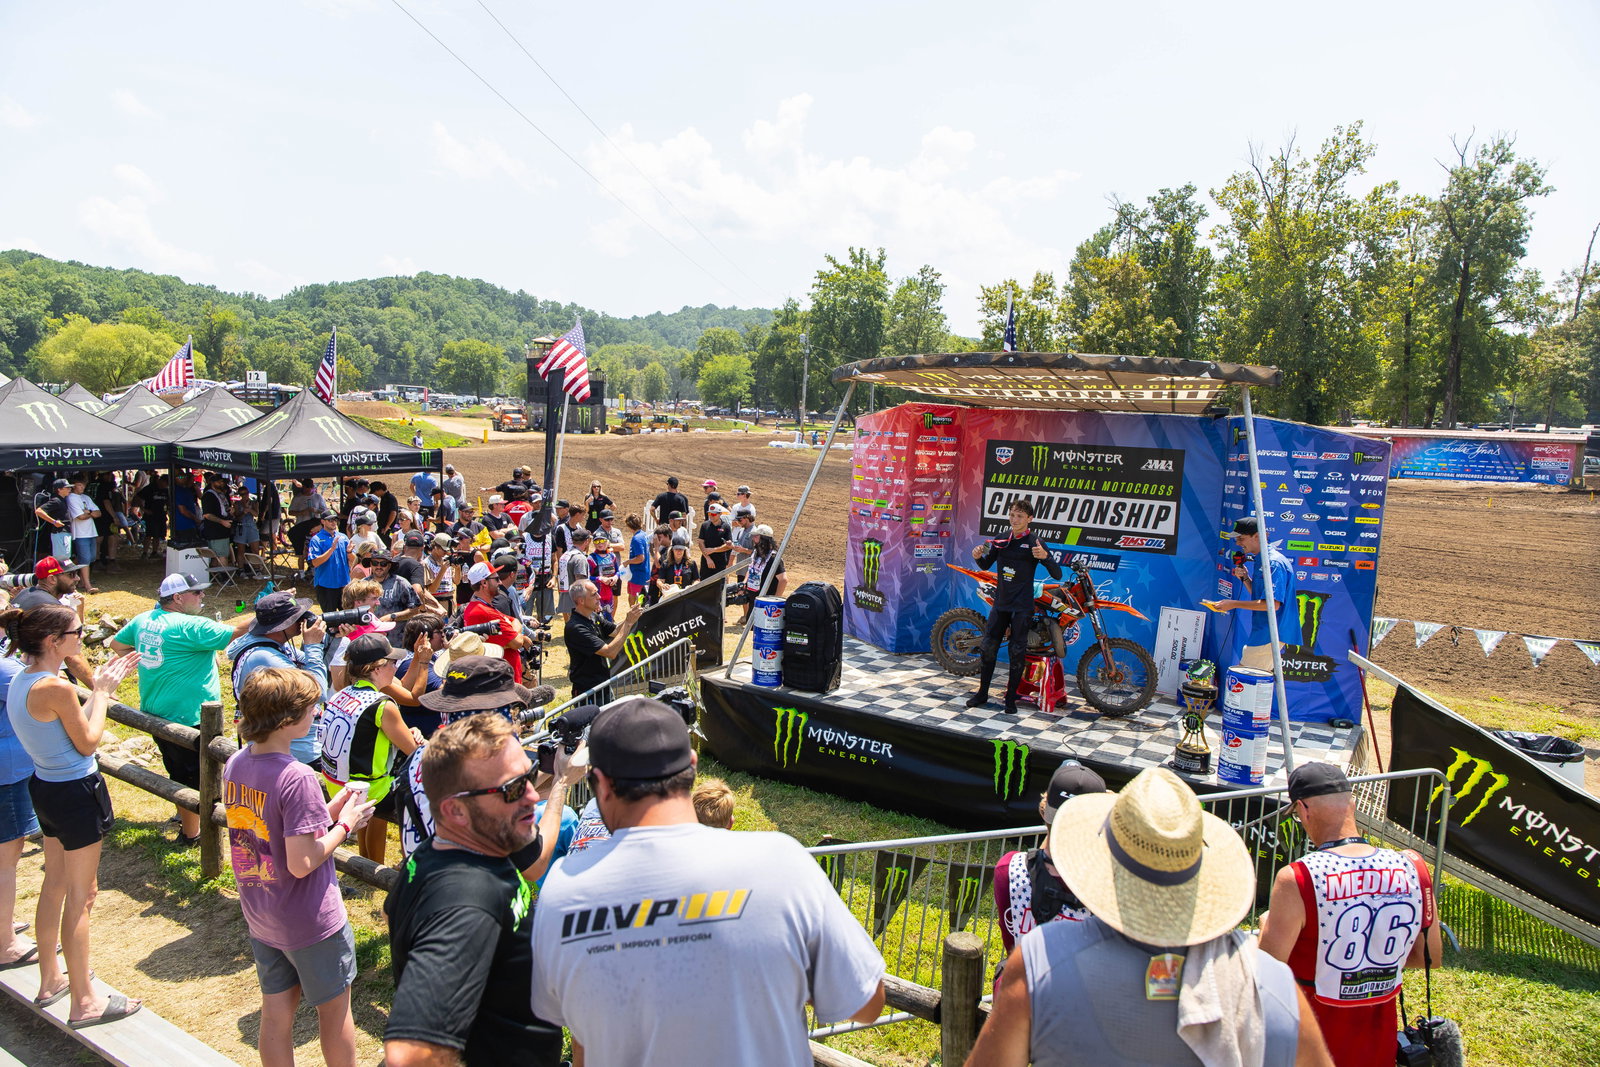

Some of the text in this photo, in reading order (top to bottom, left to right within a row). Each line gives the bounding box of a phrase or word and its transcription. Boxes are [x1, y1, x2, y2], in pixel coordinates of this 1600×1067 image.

[25, 447, 102, 459] MONSTER
[200, 450, 232, 462] MONSTER
[332, 452, 391, 464] MONSTER
[1053, 450, 1124, 466] MONSTER
[1062, 464, 1112, 472] ENERGY
[1140, 459, 1174, 472] AMA
[990, 473, 1174, 496] AMATEUR NATIONAL MOTOCROSS
[988, 492, 1172, 530] CHMPIONSHIP
[987, 524, 997, 532] AT
[1034, 528, 1061, 540] YNN'S
[1117, 536, 1166, 549] AMSOIL
[1088, 560, 1116, 570] ANNUAL
[856, 590, 882, 604] MONSTER
[646, 615, 706, 648] MONSTER
[808, 726, 894, 758] MONSTER
[818, 746, 878, 766] ENERGY
[240, 784, 267, 820] ROW
[1326, 869, 1409, 901] MEDIA
[586, 933, 712, 955] VISION IMPROVE PERFORM
[1325, 902, 1416, 970] 86
